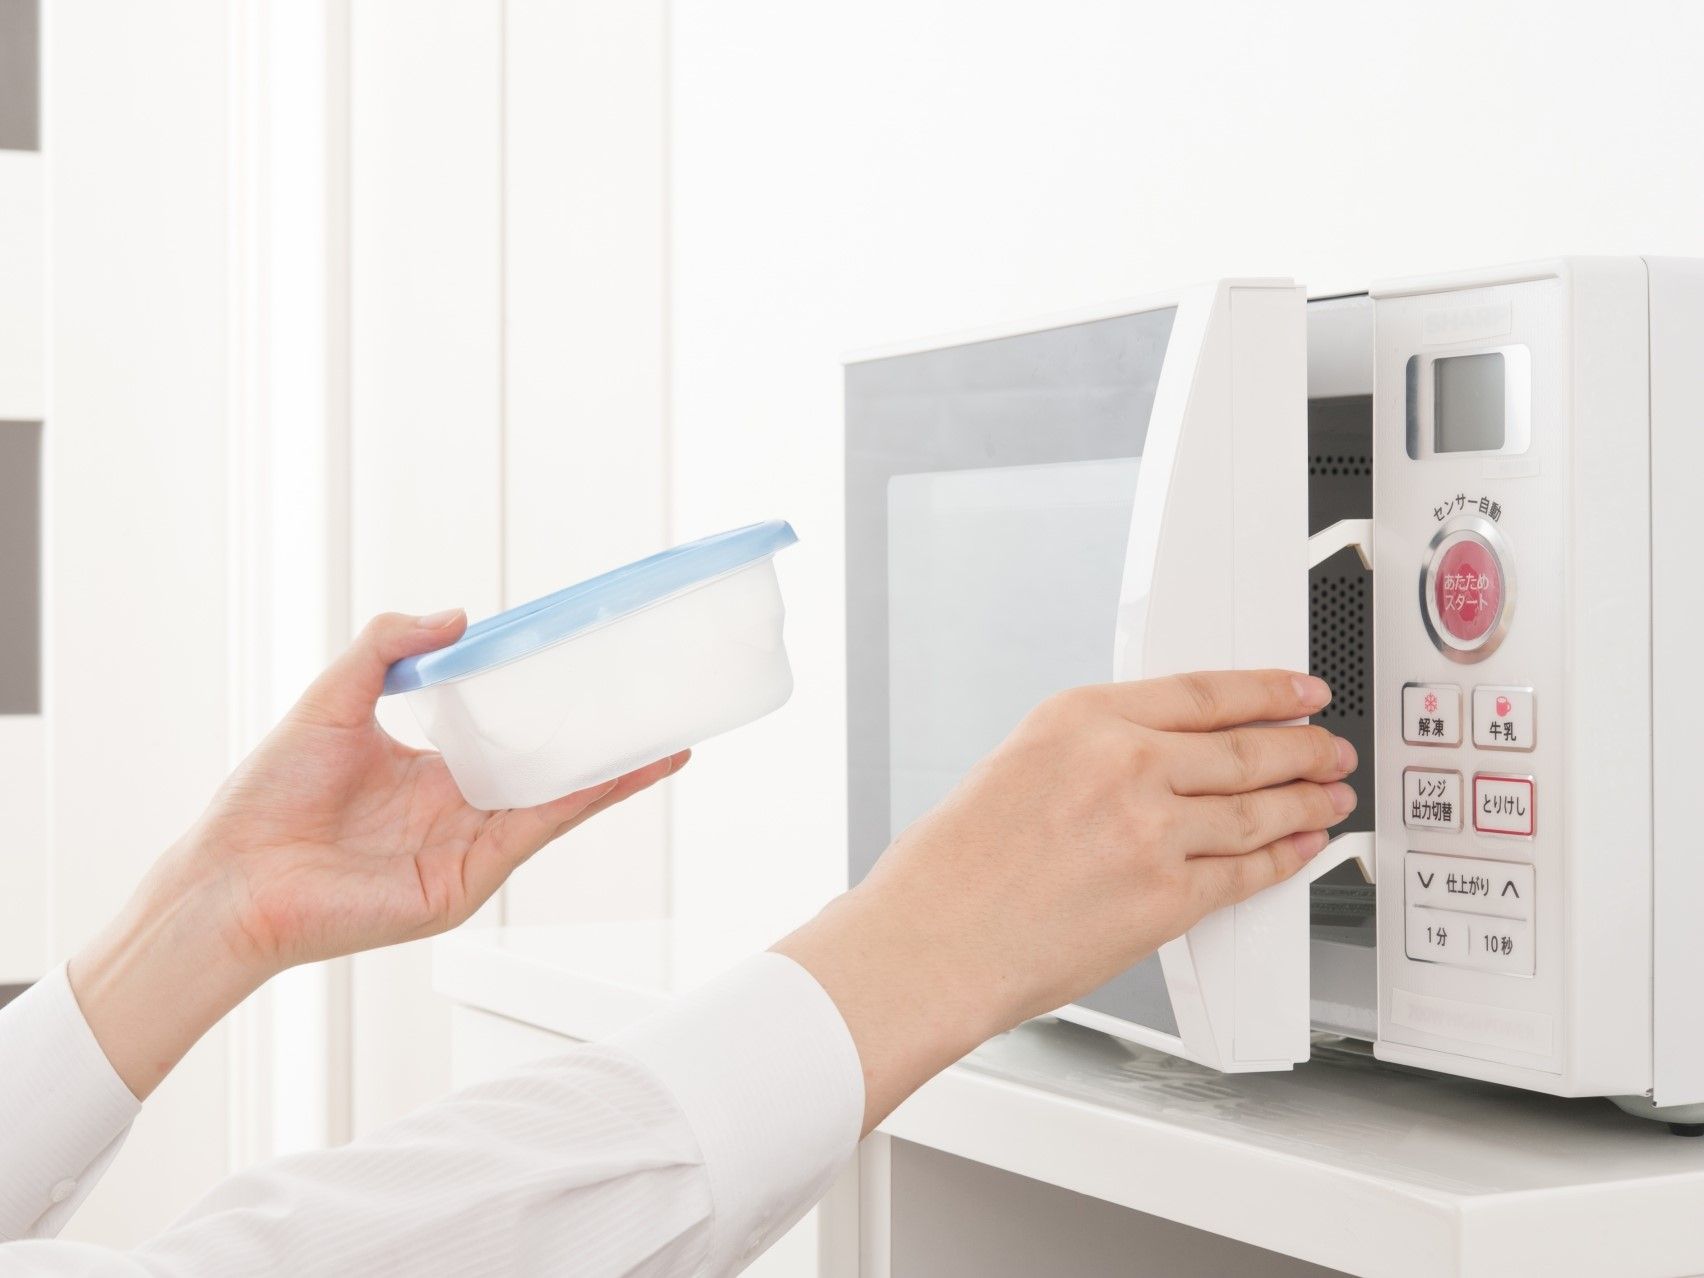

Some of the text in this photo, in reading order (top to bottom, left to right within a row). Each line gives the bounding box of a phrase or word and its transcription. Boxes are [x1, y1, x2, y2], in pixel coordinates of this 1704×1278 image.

[1433, 493, 1502, 522] センサー自動
[1444, 573, 1489, 590] あたため
[1445, 594, 1488, 611] スタート
[1418, 718, 1444, 737] 解凍
[1489, 721, 1517, 741] 牛乳
[1418, 778, 1446, 797] レンジ
[1412, 801, 1452, 822] 出力切替
[1483, 794, 1526, 816] とりけし
[1446, 873, 1490, 896] 仕上がり
[1427, 926, 1447, 946] 1分
[1484, 935, 1513, 955] 10秒
